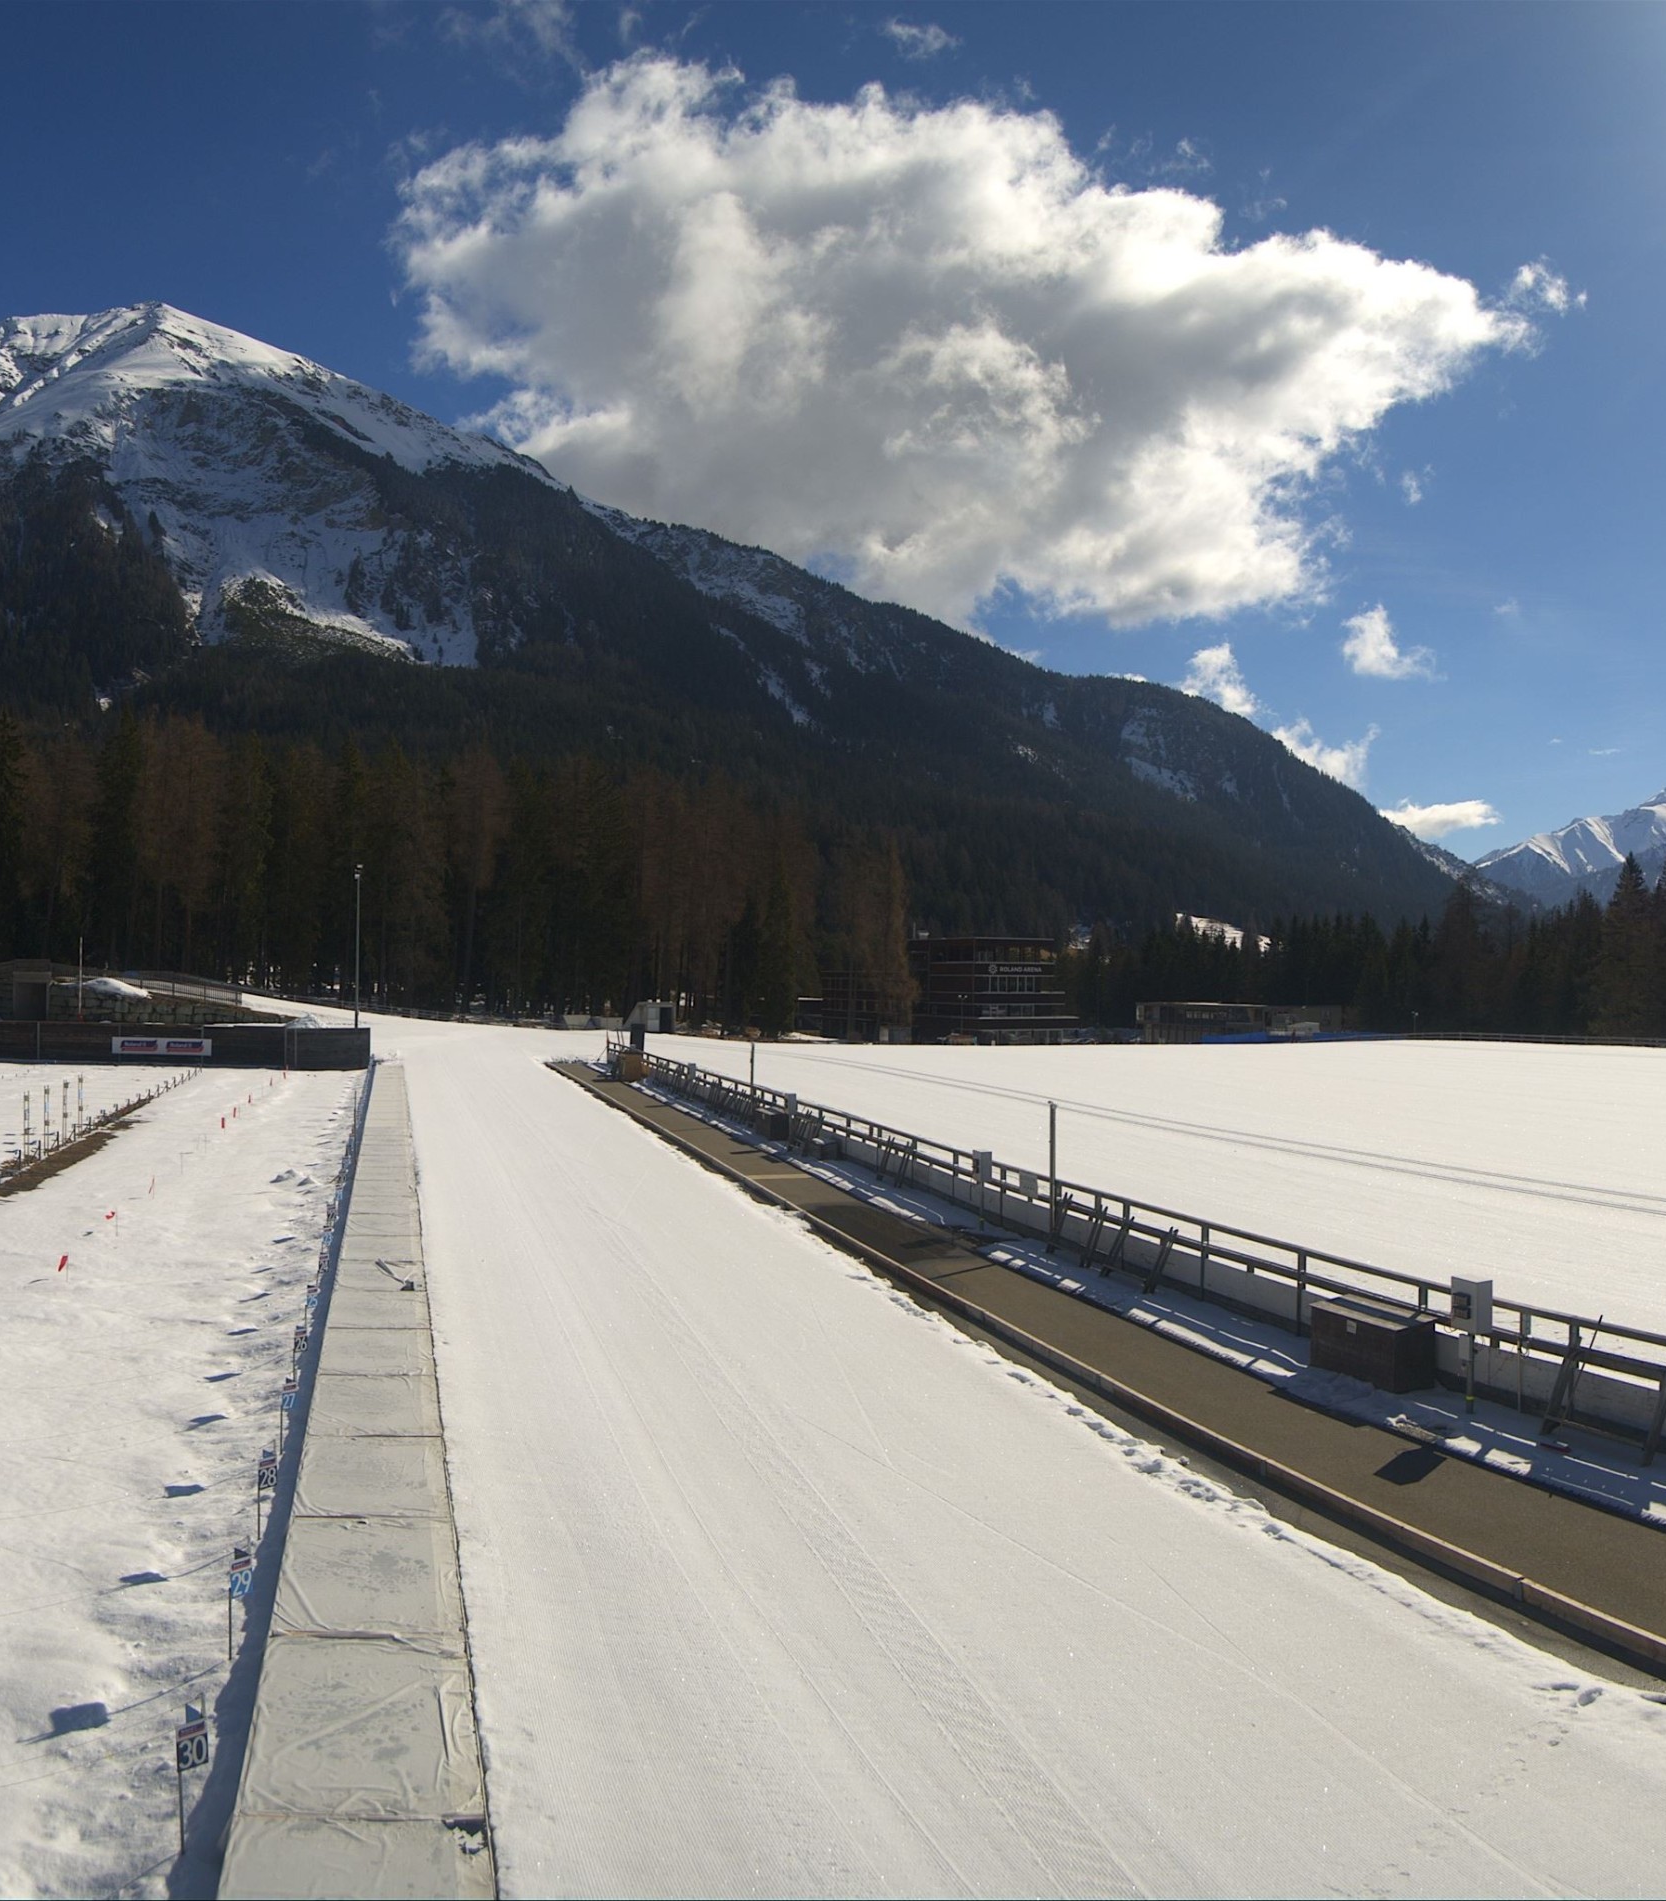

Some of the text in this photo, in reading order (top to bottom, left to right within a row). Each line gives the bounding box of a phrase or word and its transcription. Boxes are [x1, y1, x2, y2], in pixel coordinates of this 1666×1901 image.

[295, 1337, 307, 1351] 26
[283, 1393, 296, 1409] 27
[259, 1467, 277, 1489] 28
[231, 1569, 252, 1597] 29
[179, 1735, 206, 1769] 30
